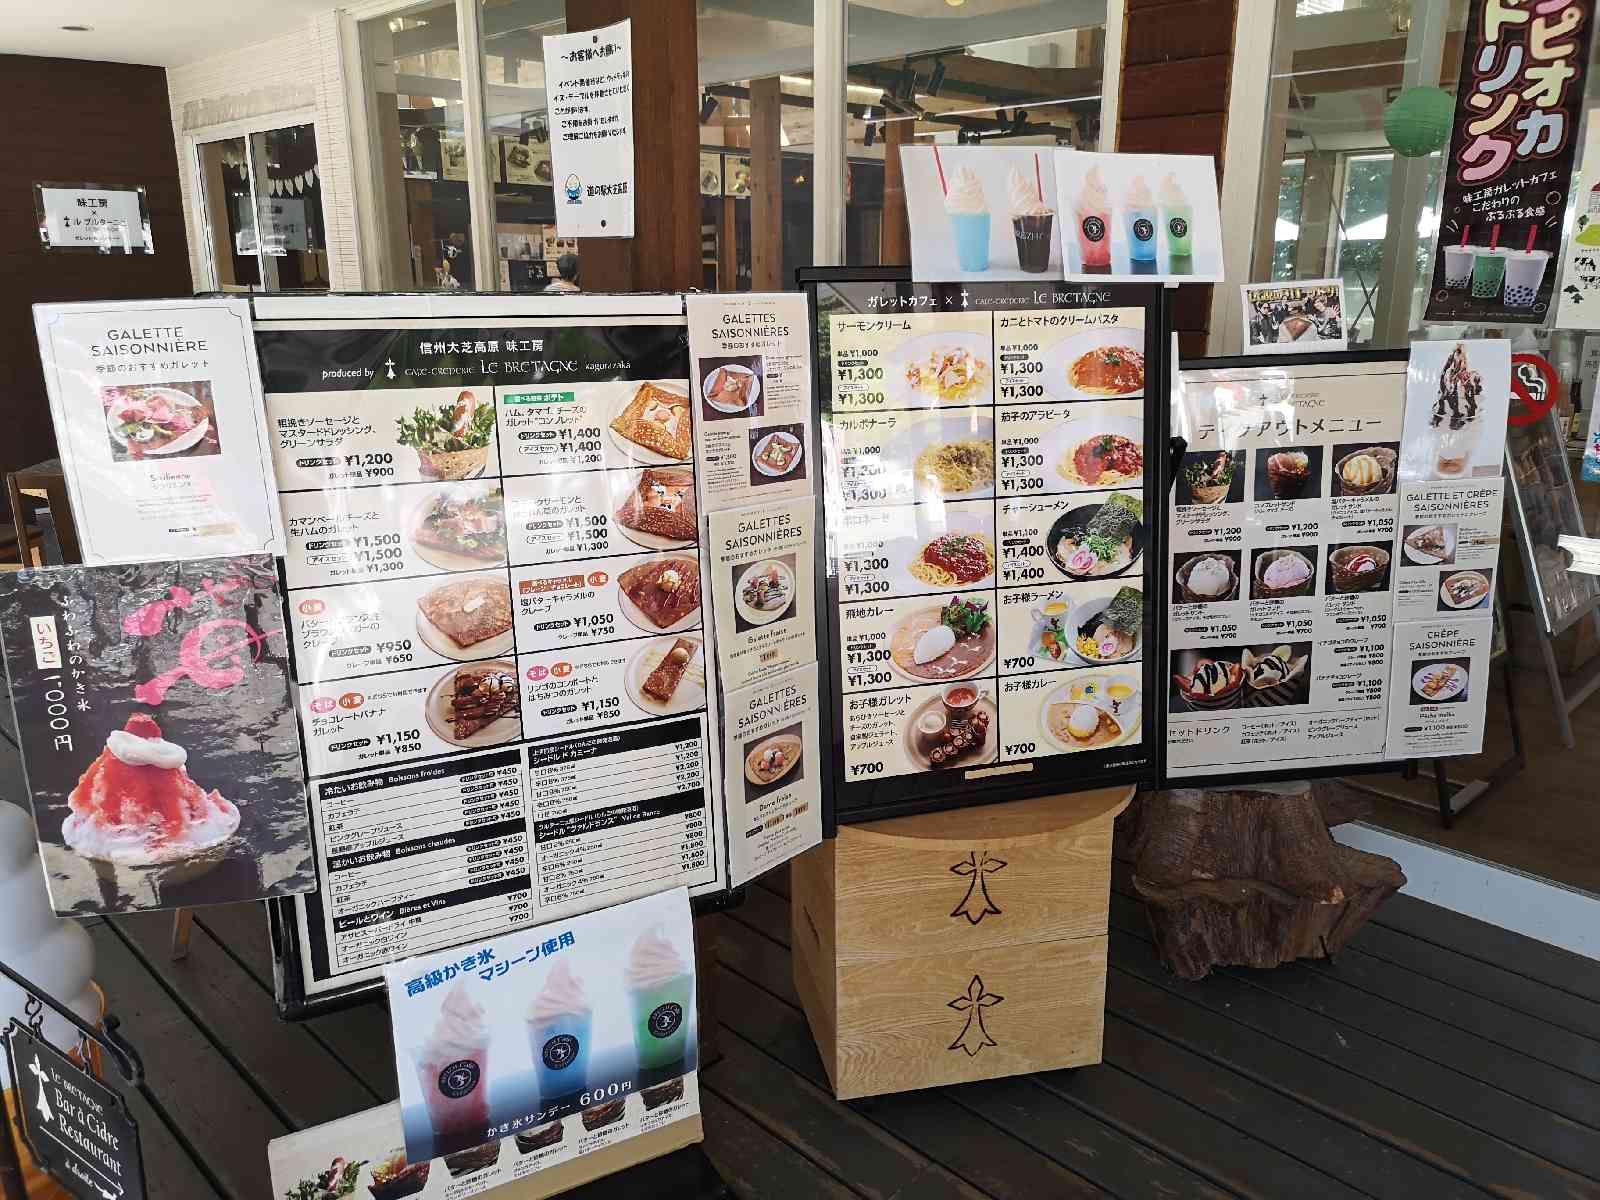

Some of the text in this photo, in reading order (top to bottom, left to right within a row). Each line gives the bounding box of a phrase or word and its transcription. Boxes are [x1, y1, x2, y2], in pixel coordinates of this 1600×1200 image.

[1516, 0, 1582, 157] ピオカ
[1472, 195, 1520, 212] こだわりの
[867, 295, 938, 308] ガレットカフェ
[722, 313, 776, 326] GALETTES
[838, 320, 912, 333] サーモンクリーム
[1000, 314, 1120, 328] カニとトマトのクリームパスタ
[107, 326, 184, 341] GALETTE
[712, 326, 789, 340] SAISONNIÈRES
[91, 339, 209, 357] SAISONNIÈRE
[420, 339, 544, 355] 信州大芝高原 味工房
[322, 368, 362, 381] produced
[364, 367, 374, 381] by
[838, 368, 884, 382] ¥1,300
[1000, 362, 1044, 376] ¥1,300
[1001, 385, 1044, 399] ¥1,300
[838, 392, 885, 407] ¥1,300
[277, 416, 361, 428] 粗挽きソーセージと
[1001, 409, 1071, 423] 茄子のアラビータ
[279, 425, 377, 438] マスタードドレッシング、
[839, 418, 897, 431] カルボナーラ
[1199, 418, 1383, 440] テクアウトメニュー
[559, 428, 601, 440] ¥1,400
[560, 441, 602, 452] ¥1,400
[345, 453, 393, 467] ¥1,200
[1001, 455, 1044, 469] ¥1,300
[365, 467, 394, 478] ¥900
[1001, 478, 1044, 492] ¥1,300
[1407, 486, 1499, 502] GALETTE ET CRÊPE
[1002, 501, 1069, 515] チャーシューメン
[1414, 499, 1490, 512] SAISONNIÈRES
[566, 515, 608, 527] ¥1,500
[738, 513, 791, 534] GALETTES
[567, 529, 608, 541] ¥1,500
[725, 526, 803, 551] SAISONNIÈRES
[1214, 527, 1242, 536] ¥1,200
[354, 533, 401, 548] ¥1,500
[576, 541, 609, 552] ¥1,300
[354, 549, 402, 563] ¥1,500
[1002, 545, 1044, 560] ¥1,400
[366, 562, 404, 574] ¥1,300
[843, 557, 889, 571] ¥1,300
[1002, 567, 1045, 582] ¥1,400
[844, 581, 890, 596] ¥1,300
[520, 592, 595, 607] 塩バターキャラメルの
[1003, 590, 1064, 605] お子様ラーメン
[573, 613, 614, 627] ¥1,050
[1286, 619, 1312, 628] ¥1,050
[1361, 614, 1386, 623] ¥1,050
[591, 626, 615, 636] ¥750
[1210, 624, 1237, 633] ¥1,050
[1370, 622, 1386, 630] ¥700
[1427, 628, 1459, 640] CRÊPE
[36, 622, 57, 664] いちご
[376, 639, 412, 653] ¥950
[1409, 638, 1477, 651] SAISONNIÈRE
[385, 653, 413, 665] ¥650
[847, 650, 892, 664] ¥1,300
[1004, 656, 1035, 669] ¥700
[528, 667, 548, 679] そば
[847, 672, 893, 687] ¥1,300
[1004, 679, 1057, 693] お子様カレー
[582, 697, 620, 711] ¥1,150
[749, 684, 797, 710] GALETTES
[849, 693, 912, 710] お子様ガレット
[312, 708, 387, 726] チョコレートバナナ
[597, 709, 620, 720] ¥850
[313, 724, 345, 736] ガレット
[376, 729, 421, 745] ¥1,150
[1169, 726, 1231, 738] セットドリンク
[394, 742, 421, 754] ¥850
[1005, 742, 1036, 756] ¥700
[497, 767, 517, 778] ¥450
[850, 762, 884, 776] ¥700
[498, 778, 519, 788] ¥450
[499, 788, 519, 798] ¥450
[500, 799, 520, 810] ¥450
[501, 810, 521, 820] ¥450
[502, 835, 523, 846] ¥450
[503, 845, 524, 856] ¥450
[505, 856, 525, 867] ¥450
[506, 866, 526, 877] ¥450
[507, 890, 528, 902] ¥700
[508, 901, 529, 912] ¥700
[338, 910, 394, 930] ビールとワイン
[509, 911, 529, 923] ¥700
[478, 930, 576, 982] マシーン使用
[404, 948, 497, 997] 高級かき氷
[487, 1080, 633, 1138] かき氷サンデー 600円
[55, 1087, 119, 1151] Bar à Cidre
[58, 1112, 122, 1177] Restaurant
